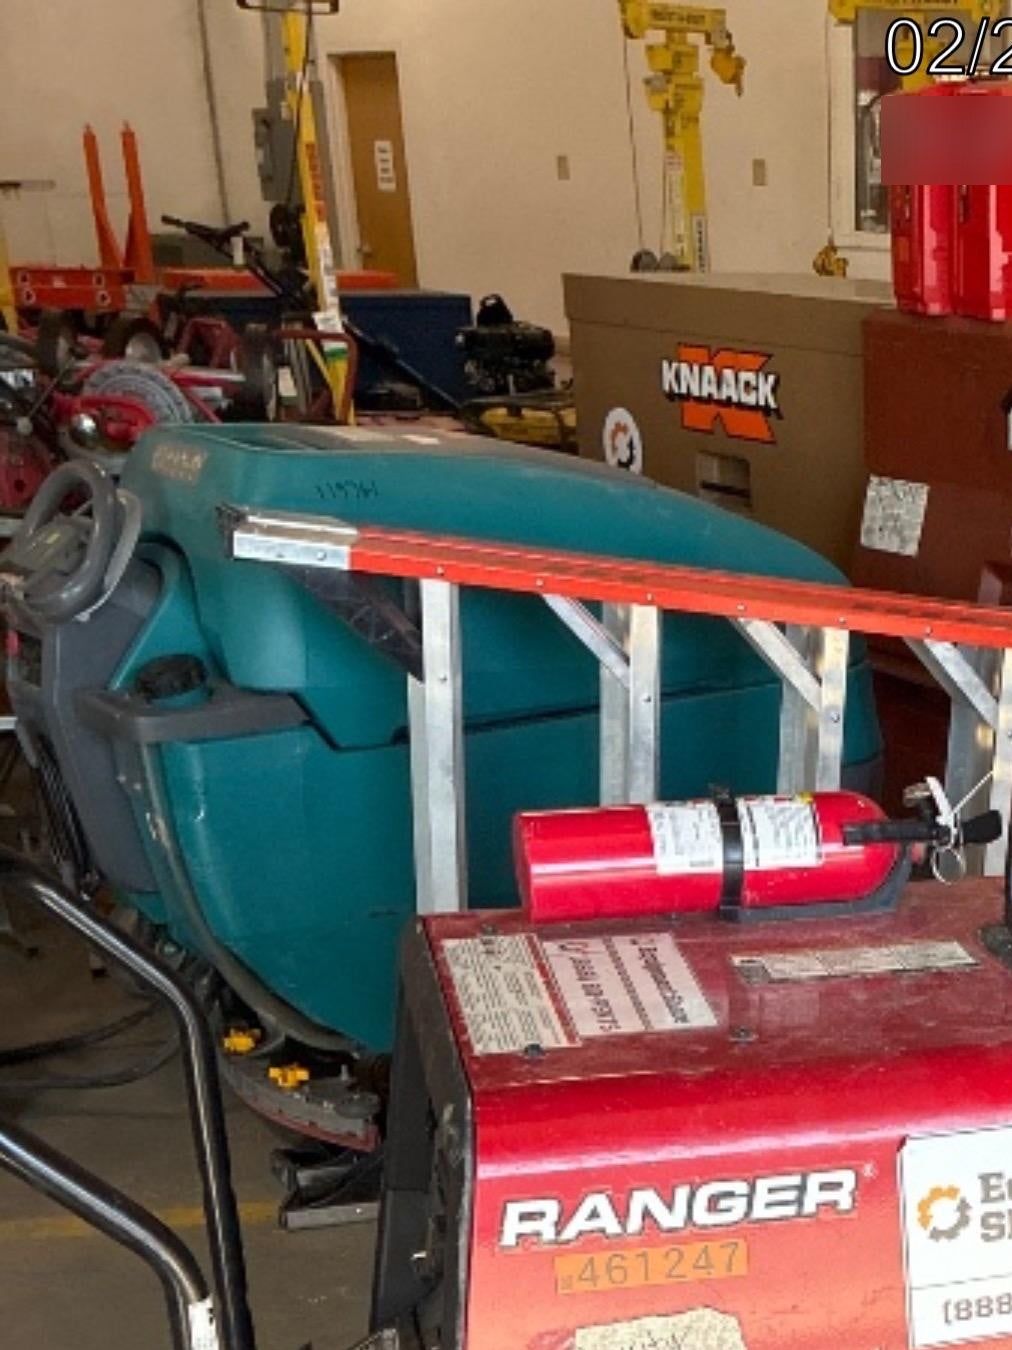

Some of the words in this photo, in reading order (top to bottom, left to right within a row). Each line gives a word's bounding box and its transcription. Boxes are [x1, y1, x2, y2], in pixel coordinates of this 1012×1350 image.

[661, 359, 779, 411] KNAACK
[498, 1167, 857, 1248] RANGER
[577, 1241, 740, 1288] 461247
